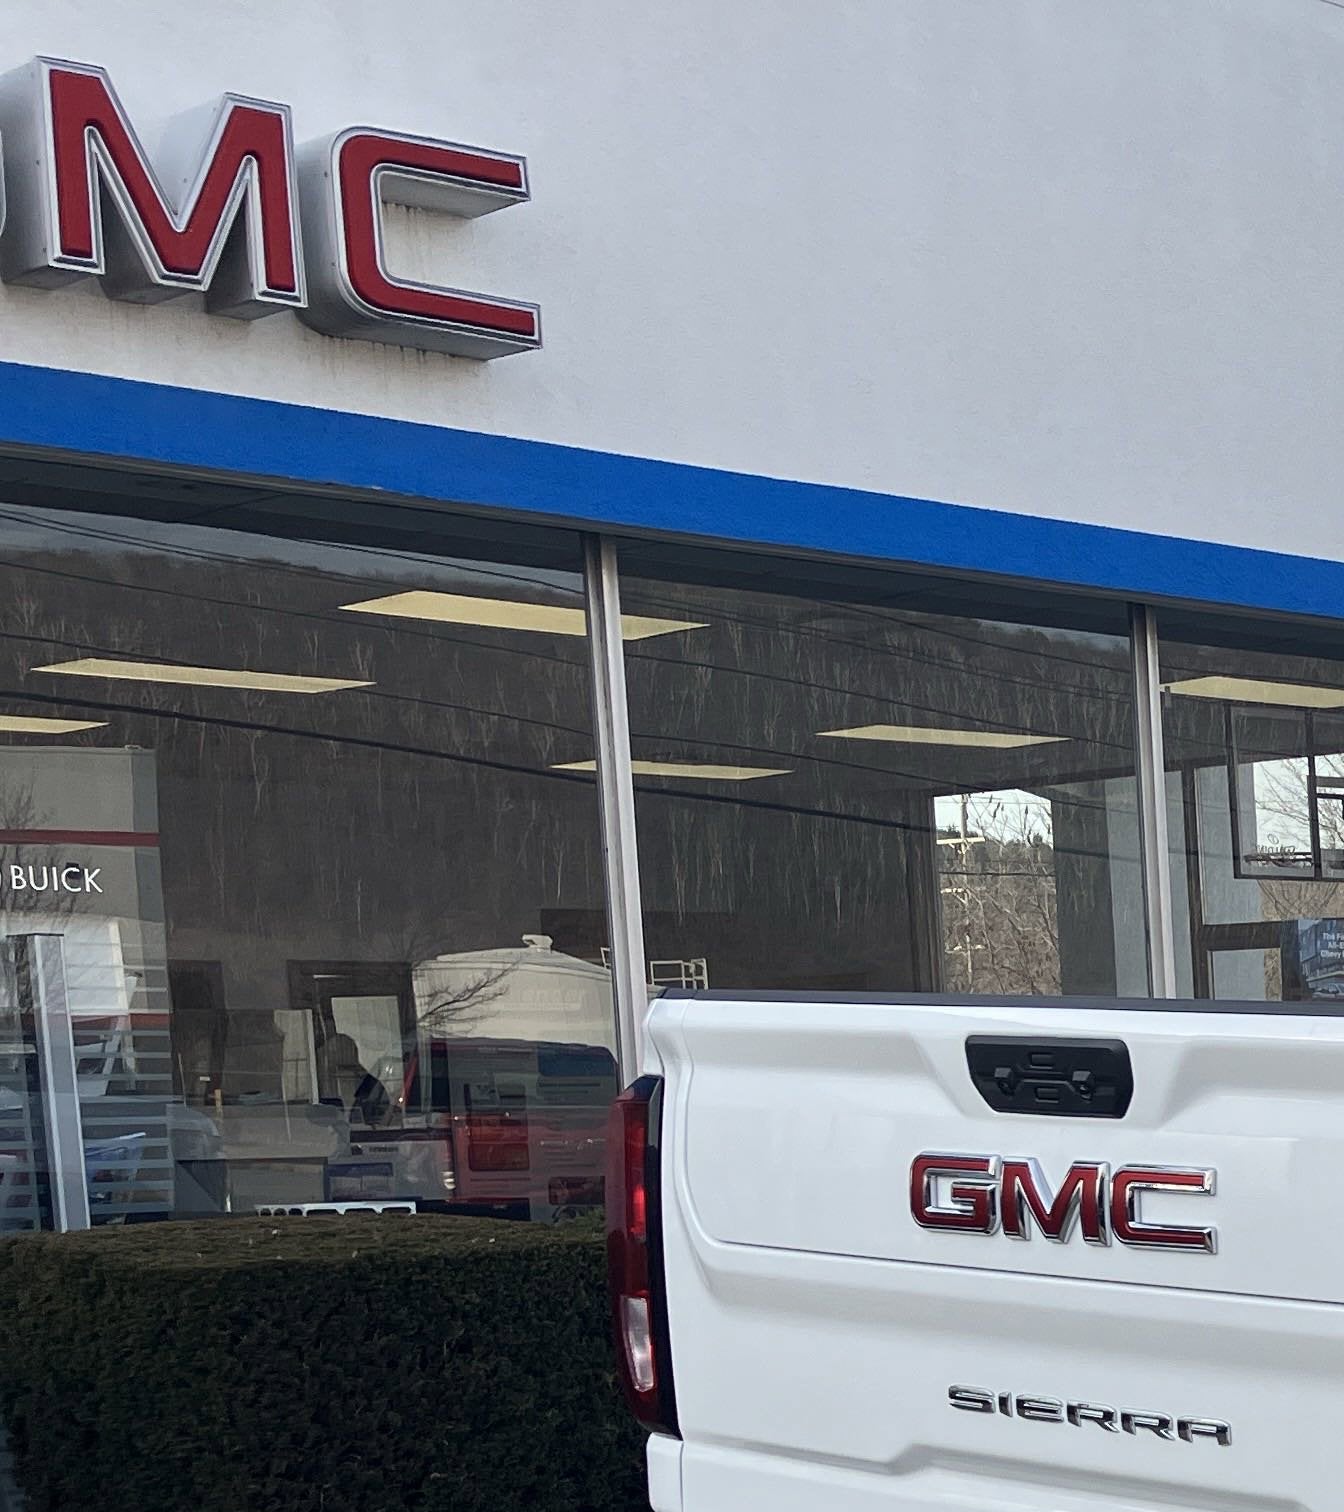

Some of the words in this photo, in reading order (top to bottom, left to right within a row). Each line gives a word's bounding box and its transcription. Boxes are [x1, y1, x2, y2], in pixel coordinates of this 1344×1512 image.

[0, 55, 542, 358] MC
[10, 864, 103, 893] BUICK
[1320, 950, 1341, 960] Chevy
[910, 1150, 1218, 1255] GMC
[948, 1384, 1232, 1447] SIERRA
